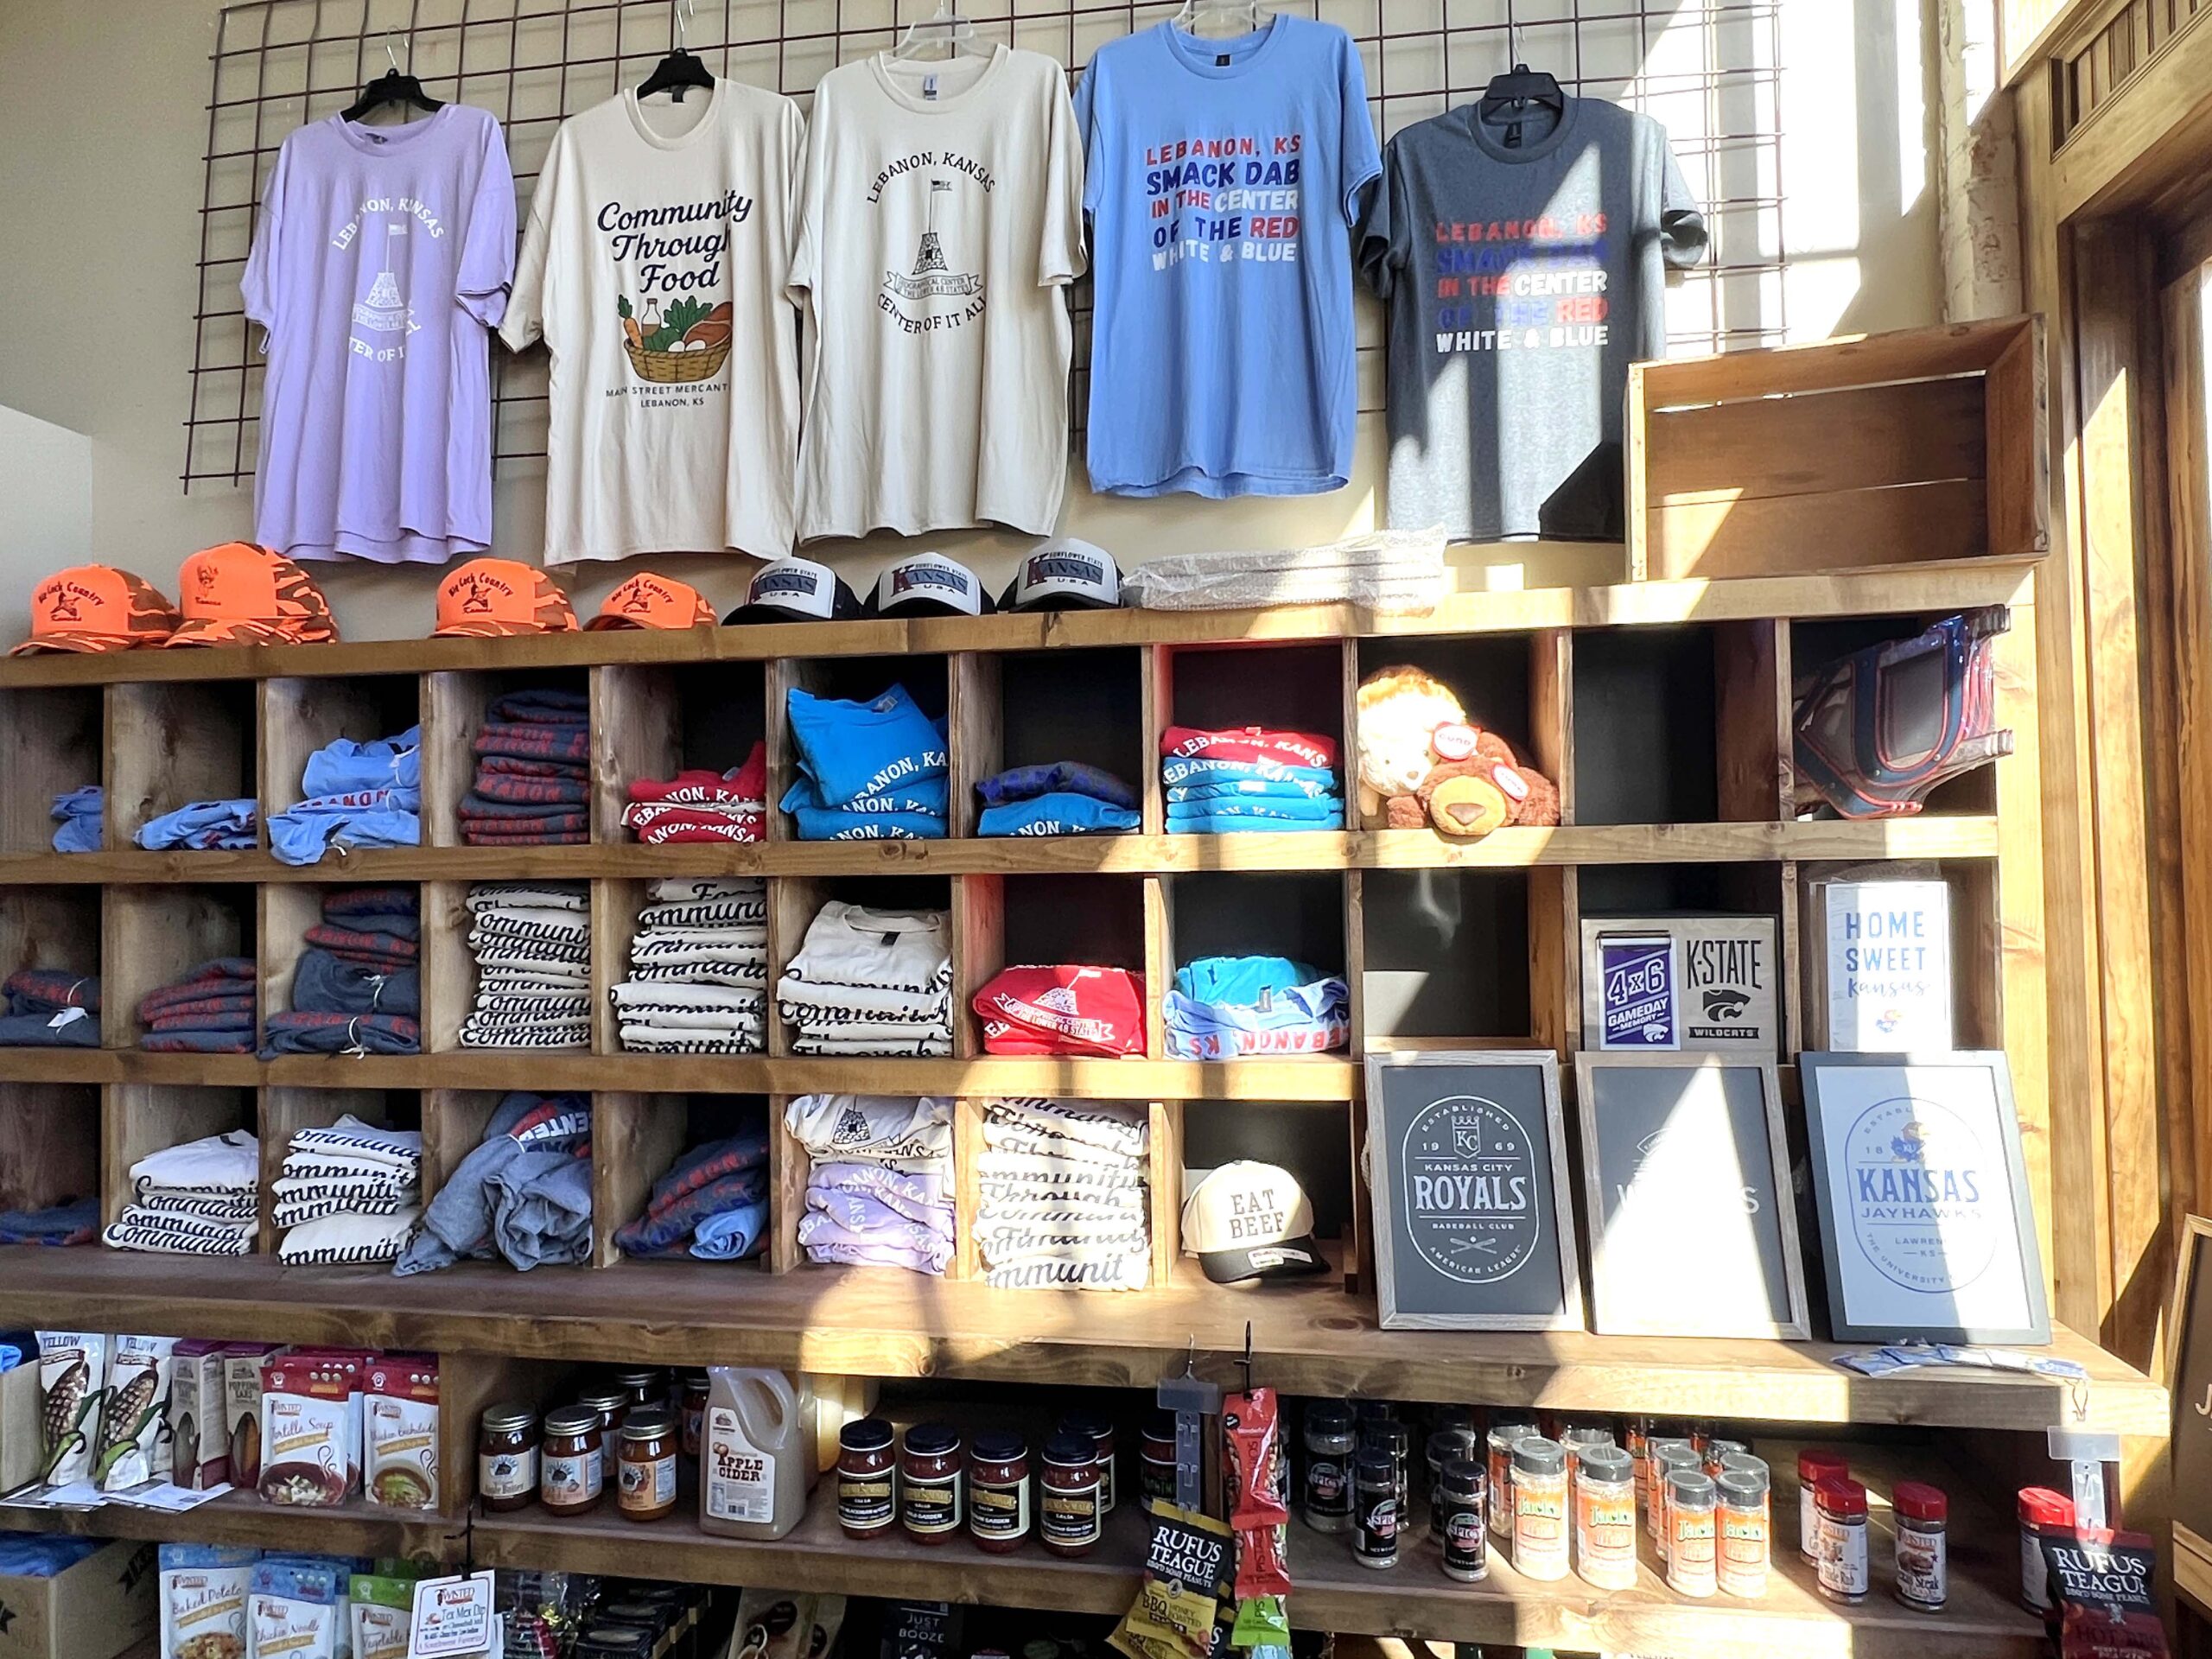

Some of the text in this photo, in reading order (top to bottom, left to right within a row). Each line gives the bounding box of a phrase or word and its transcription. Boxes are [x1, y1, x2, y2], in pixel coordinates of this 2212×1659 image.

[1146, 134, 1301, 166] LEBANON, KS
[868, 151, 995, 204] LEBANON, KANSAS
[1147, 159, 1300, 195] SMACK DAB
[597, 189, 753, 232] Community
[1152, 188, 1299, 219] IN THE CENTER
[1154, 216, 1300, 248] OF THE RED
[1435, 213, 1607, 243] LEBANON, KS
[1152, 239, 1297, 271] WHITE & BLUE
[639, 261, 720, 294] Food
[1437, 270, 1608, 299] IN THE CENTER
[878, 293, 922, 334] CENTER
[924, 315, 942, 332] OF
[945, 313, 961, 328] IT
[1438, 296, 1610, 330] OF THE RED
[349, 336, 374, 361] TER
[377, 349, 395, 362] OF
[1436, 325, 1609, 353] WHITE & BLUE
[632, 385, 671, 395] STREET
[675, 383, 728, 393] MERCANT
[640, 397, 704, 408] LEBANON, KS
[480, 572, 513, 596] Country
[1846, 912, 1924, 939] HOME
[1687, 940, 1763, 990] K-STATE
[1846, 947, 1926, 972] SWEET
[1607, 958, 1666, 1006] 4x6
[1608, 997, 1669, 1027] GAMEDAY
[1694, 1028, 1755, 1038] WILDCATS
[1421, 1104, 1510, 1132] ESTABLISHED
[1864, 1107, 1912, 1134] ESTABL
[1423, 1141, 1515, 1151] 19 69
[1456, 1130, 1478, 1152] KC
[1413, 1175, 1527, 1211] ROYALS
[1855, 1168, 1980, 1203] KANSAS
[1230, 1189, 1274, 1215] EAT
[1861, 1207, 1981, 1219] JAYHAWKS
[1229, 1211, 1285, 1239] BEEF
[1430, 1246, 1481, 1274] AMERICAN
[1866, 1232, 1945, 1283] THE UNIVERSITY
[43, 1336, 81, 1348] YELLOW
[308, 1418, 334, 1436] Soup
[718, 1454, 763, 1471] APPLE
[719, 1467, 760, 1482] CIDER
[1154, 1526, 1223, 1562] RUFUS
[1151, 1543, 1216, 1580] TEAGUE
[2052, 1548, 2146, 1576] RUFUS
[2059, 1569, 2147, 1595] TEAGUE
[173, 1582, 242, 1615] Baked Potato
[1142, 1593, 1167, 1617] BBQ
[906, 1612, 940, 1627] JUST
[899, 1628, 944, 1643] BOOZE
